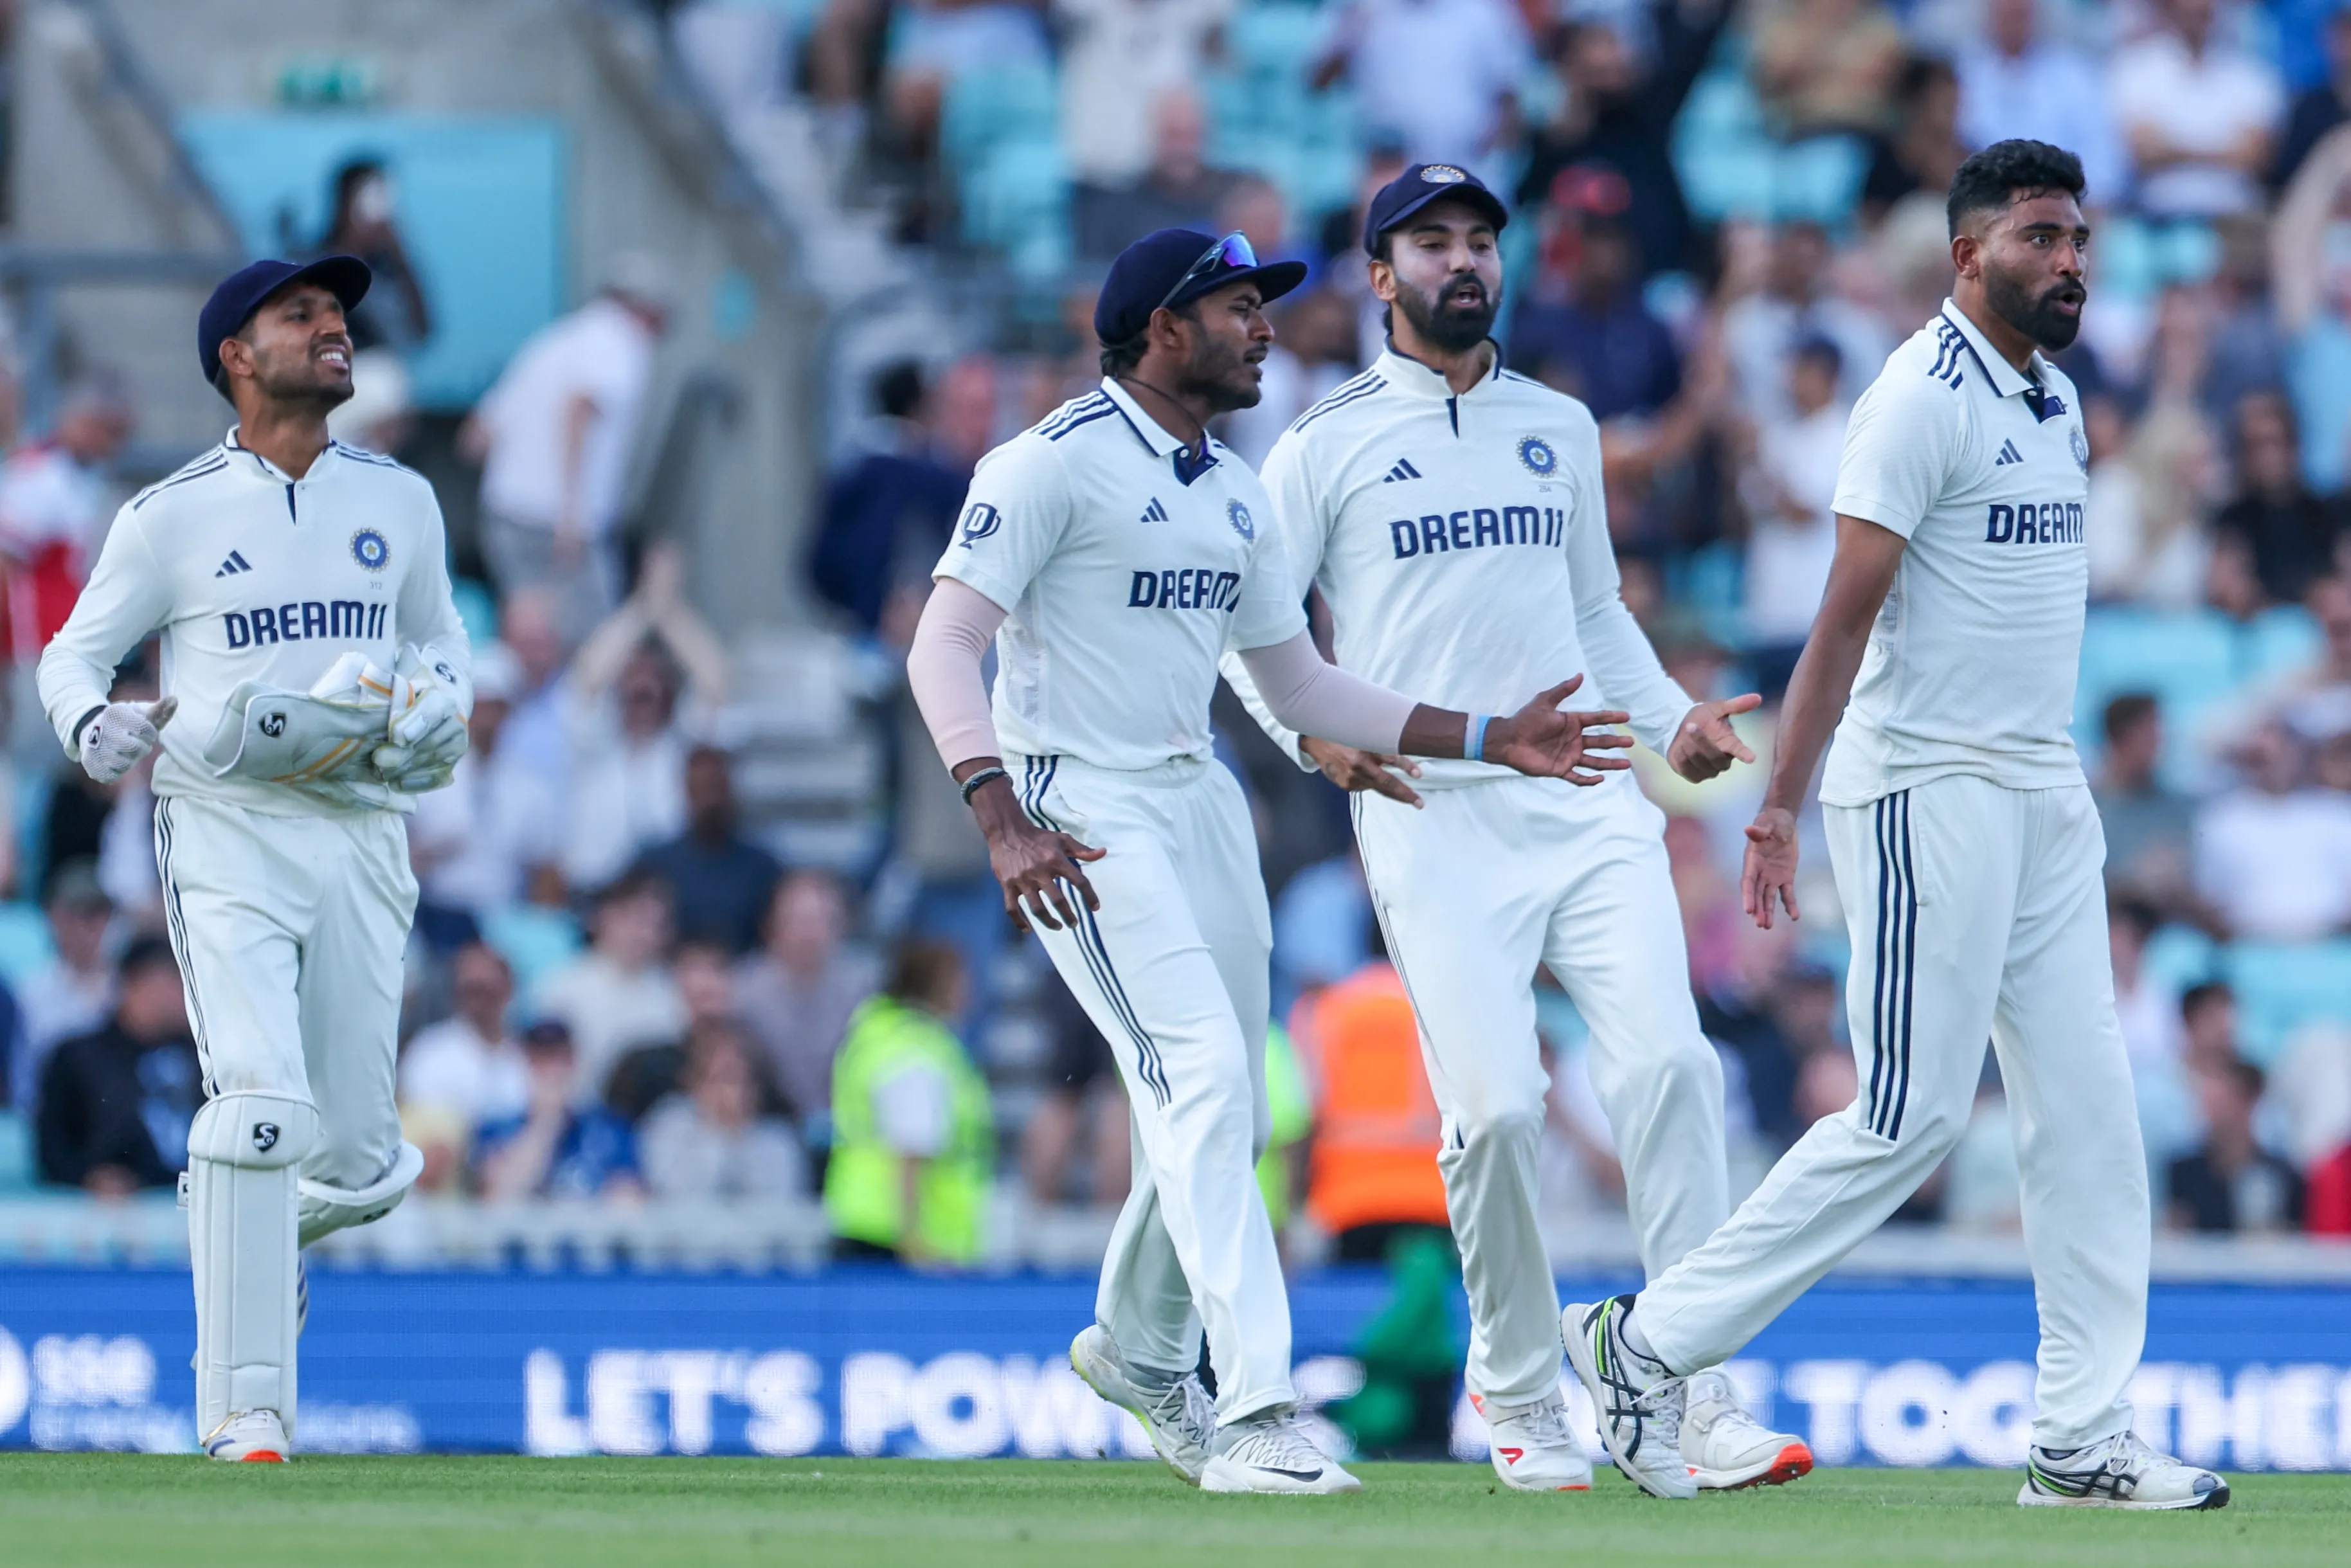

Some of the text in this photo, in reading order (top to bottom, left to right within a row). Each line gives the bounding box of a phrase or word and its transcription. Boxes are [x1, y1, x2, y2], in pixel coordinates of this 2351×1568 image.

[1389, 506, 1563, 559] DREAM11
[1983, 503, 2085, 544] DREAM
[223, 600, 387, 649] DREAM11
[523, 1347, 825, 1457] LET'S
[1785, 1358, 2351, 1472] TOGTHE
